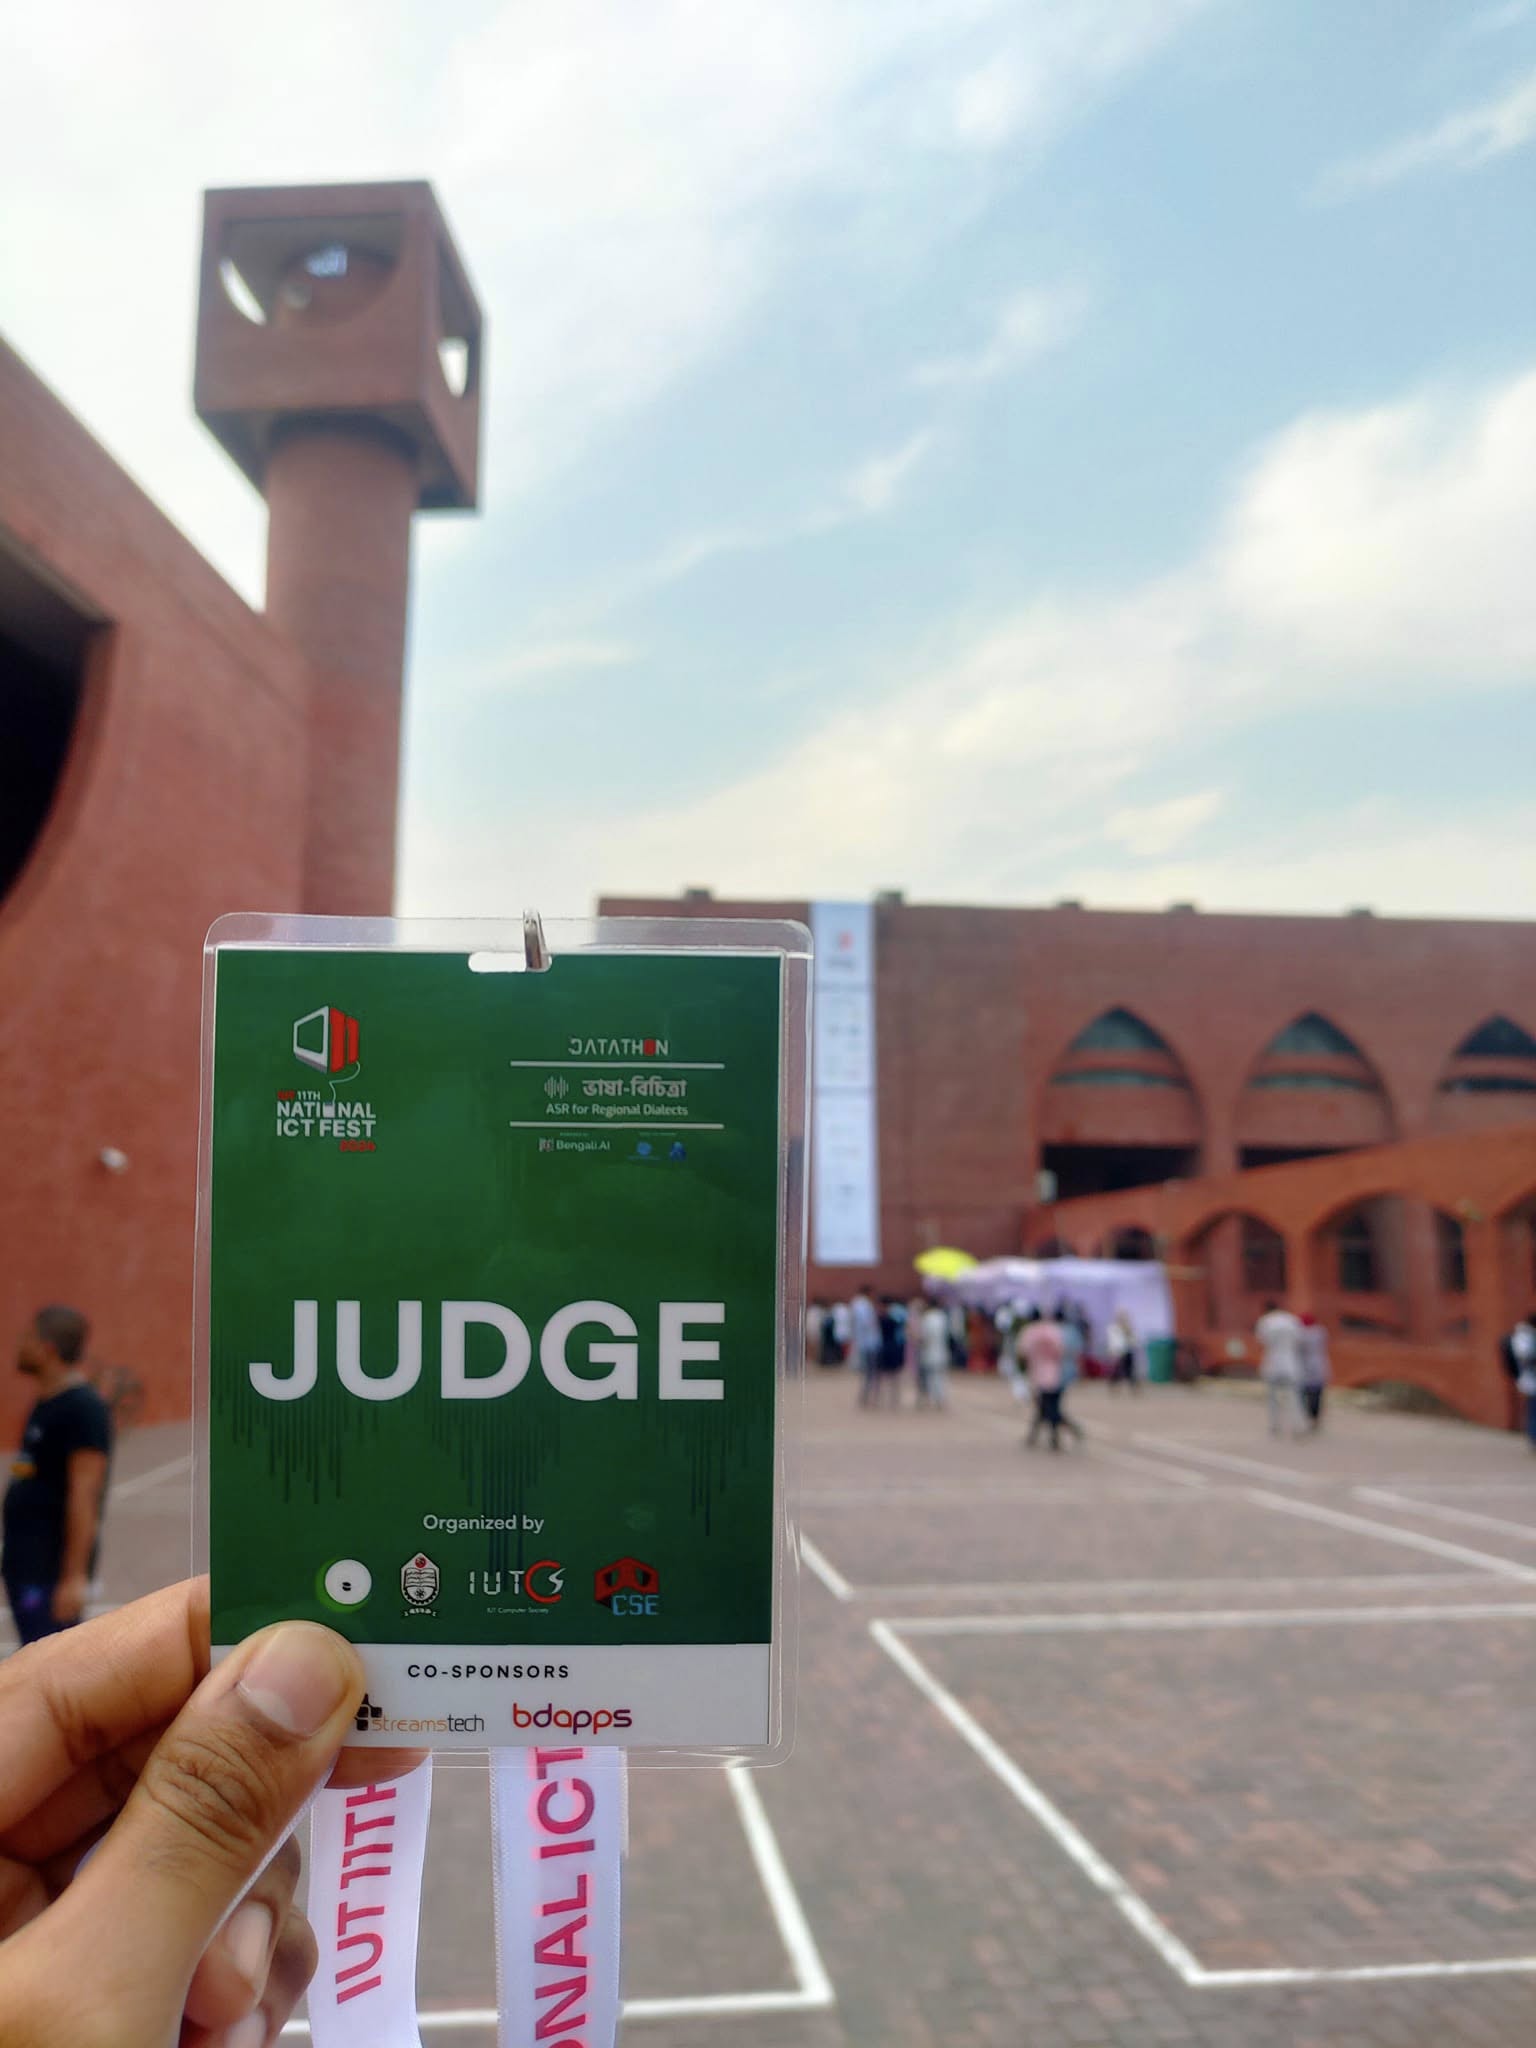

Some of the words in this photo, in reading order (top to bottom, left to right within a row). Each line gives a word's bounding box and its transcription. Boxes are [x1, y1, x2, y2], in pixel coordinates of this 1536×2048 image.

[297, 1090, 320, 1101] 11TH
[582, 1076, 687, 1098] ভাষা-বিচিত্রা
[546, 1103, 569, 1115] ASR
[572, 1103, 589, 1115] for
[592, 1103, 641, 1118] Regional
[643, 1103, 688, 1116] Dialects
[276, 1119, 315, 1137] ICT
[319, 1119, 377, 1138] FEST
[249, 1300, 725, 1400] JUDGE
[422, 1514, 516, 1533] Organized
[521, 1514, 545, 1533] by
[612, 1594, 659, 1616] CSE
[407, 1664, 570, 1679] CO-SPONSORS
[371, 1714, 485, 1733] streamstech
[512, 1702, 633, 1735] bdapps
[335, 1901, 386, 2005] IUT
[534, 1873, 589, 2048] NAL
